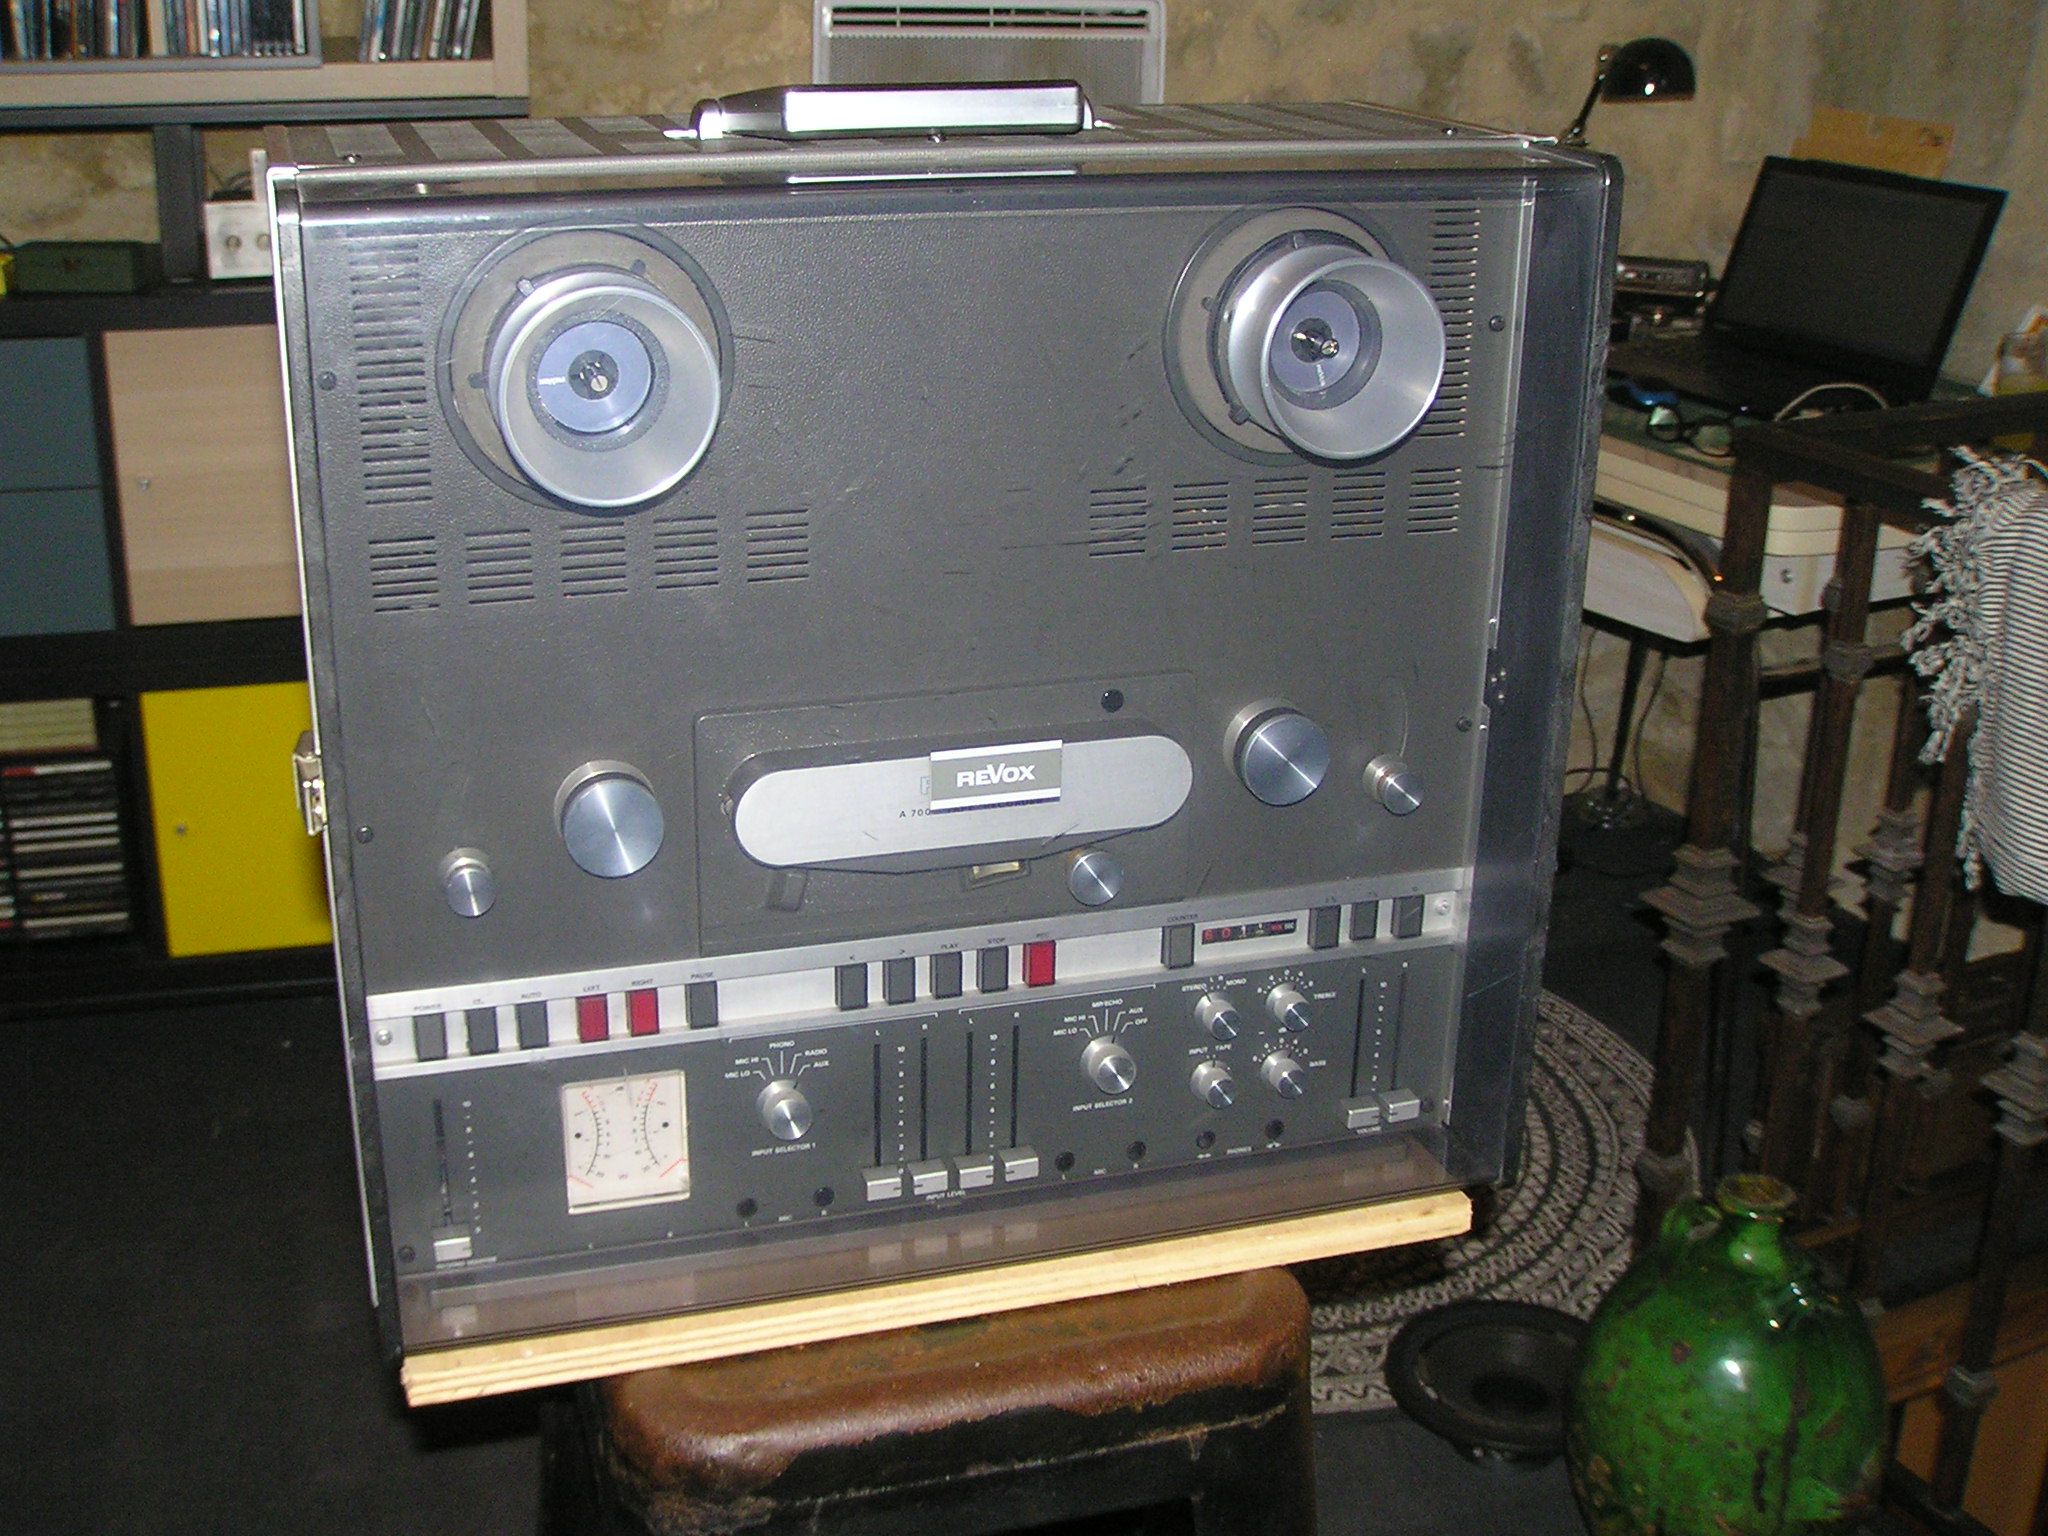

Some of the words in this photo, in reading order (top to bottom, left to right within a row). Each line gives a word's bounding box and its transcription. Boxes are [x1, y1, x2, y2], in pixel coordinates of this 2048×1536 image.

[899, 810, 906, 818] A
[1167, 914, 1198, 923] COUNTER
[987, 936, 1005, 945] STOP
[941, 942, 958, 950] PLAY
[690, 971, 713, 980] PAUSE
[631, 978, 654, 987] RIGHT
[1226, 977, 1247, 987] MONO
[583, 984, 600, 992] LEFT
[1181, 983, 1207, 993] STEREO
[1064, 1015, 1079, 1023] MIC
[1135, 1018, 1148, 1026] OFF
[1053, 1029, 1066, 1037] MIC
[769, 1040, 795, 1050] PHONO
[1215, 1043, 1232, 1051] TAPE
[805, 1047, 828, 1057] RADIO
[735, 1057, 750, 1066] MIC
[751, 1055, 760, 1063] HI
[813, 1060, 830, 1068] AUX
[724, 1071, 739, 1079] MIC
[740, 1069, 751, 1077] LO
[1072, 1103, 1093, 1113] INPUT
[1094, 1097, 1127, 1110] SELECTOR
[751, 1147, 774, 1158] INPUT
[774, 1142, 811, 1154] SELECTOR
